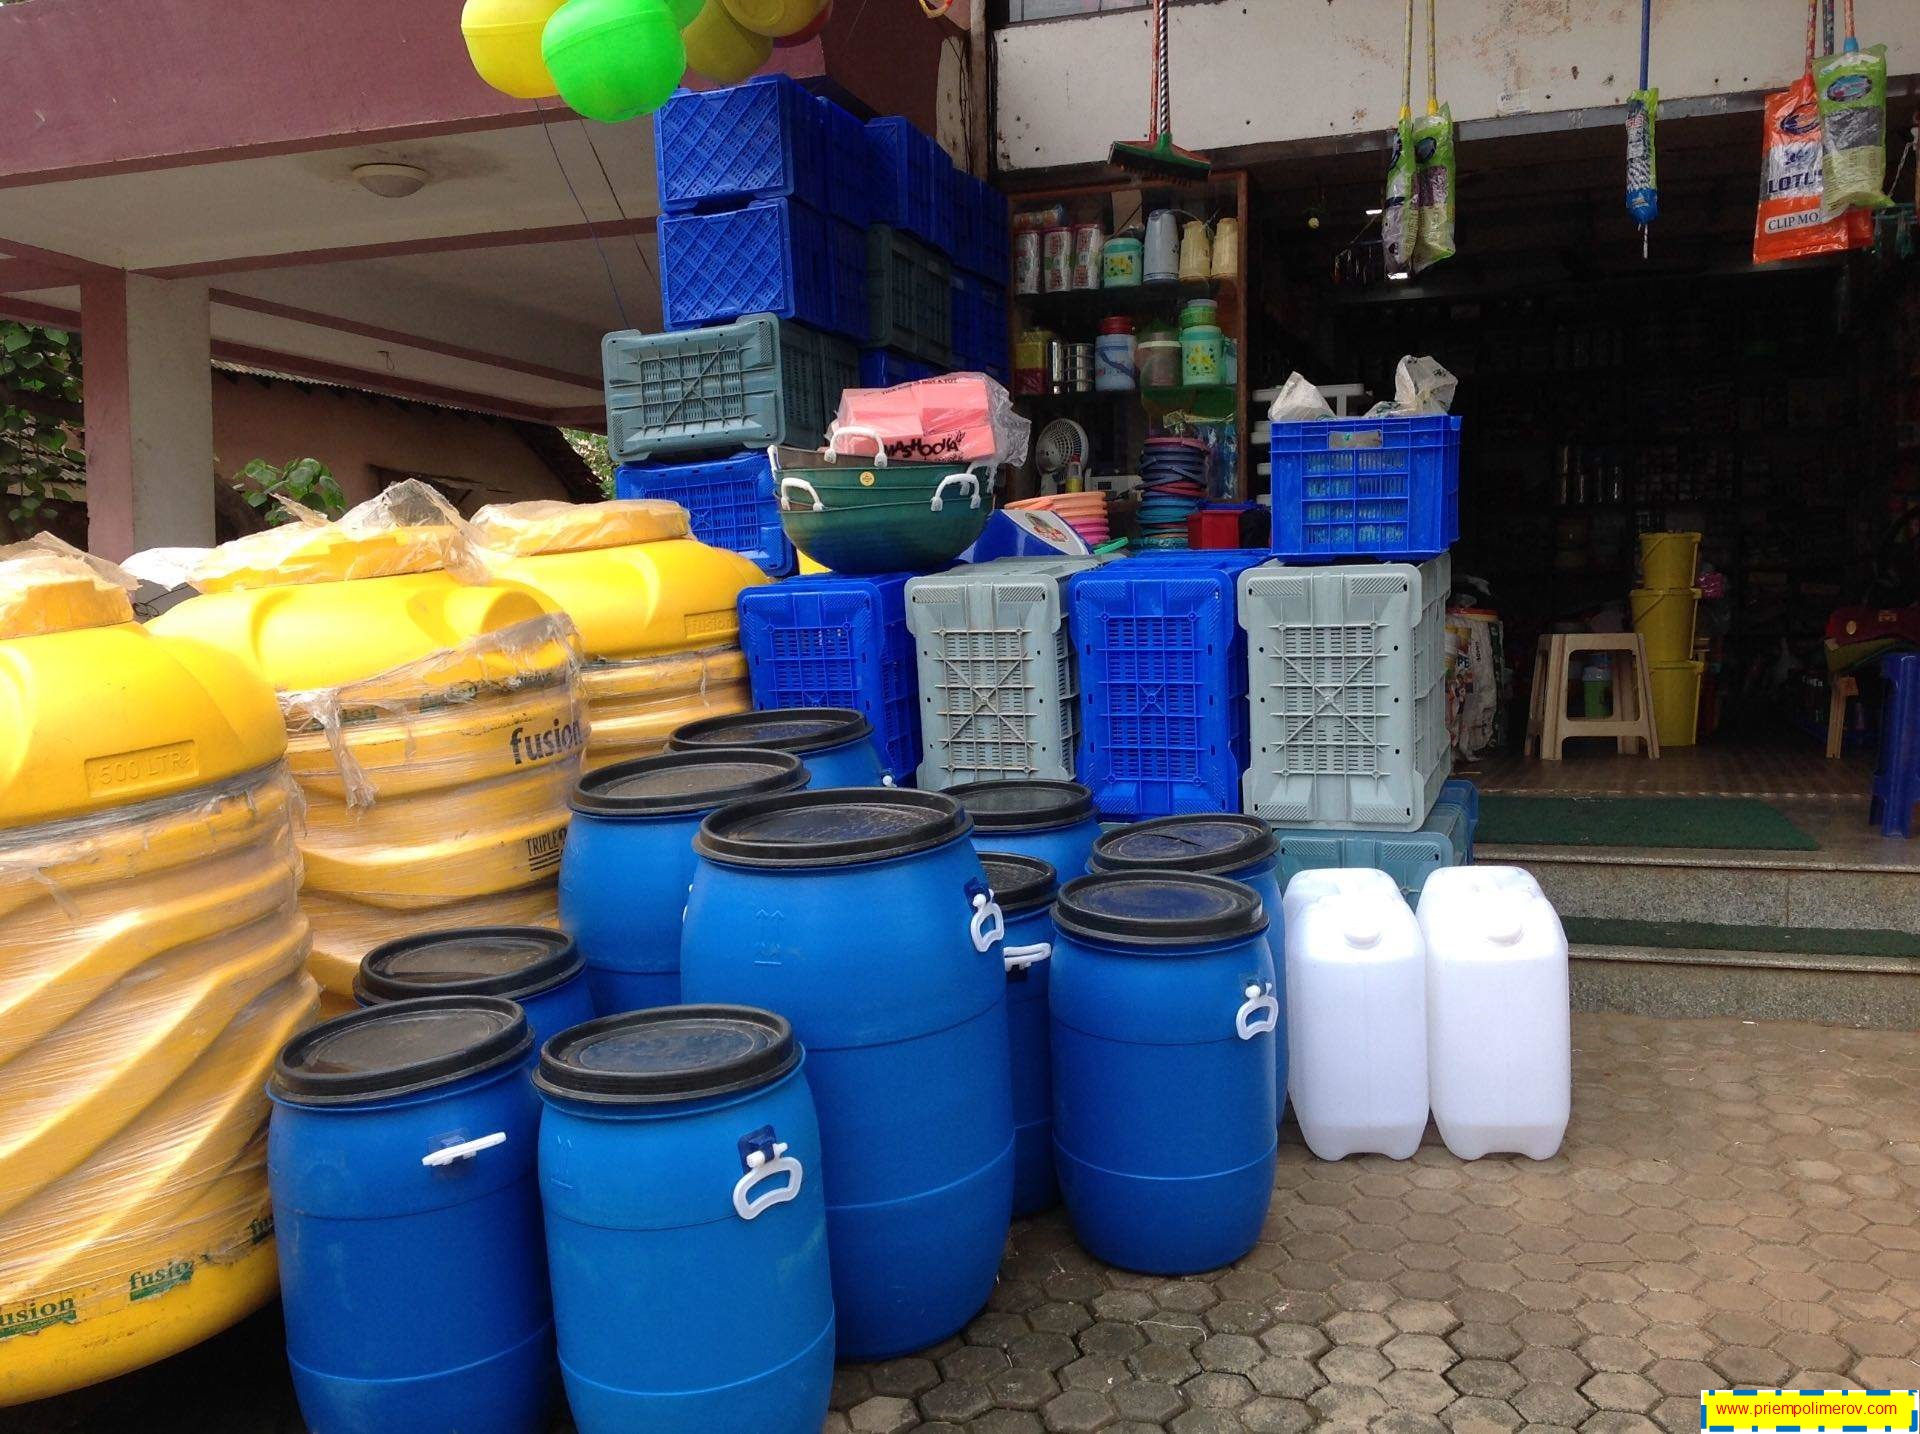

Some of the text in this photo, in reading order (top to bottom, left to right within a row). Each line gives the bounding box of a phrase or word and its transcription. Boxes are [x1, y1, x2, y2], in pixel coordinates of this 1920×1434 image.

[1768, 211, 1822, 231] CLIP MO
[510, 718, 583, 765] fusion
[99, 760, 140, 784] 500
[527, 830, 560, 856] TRIPLE
